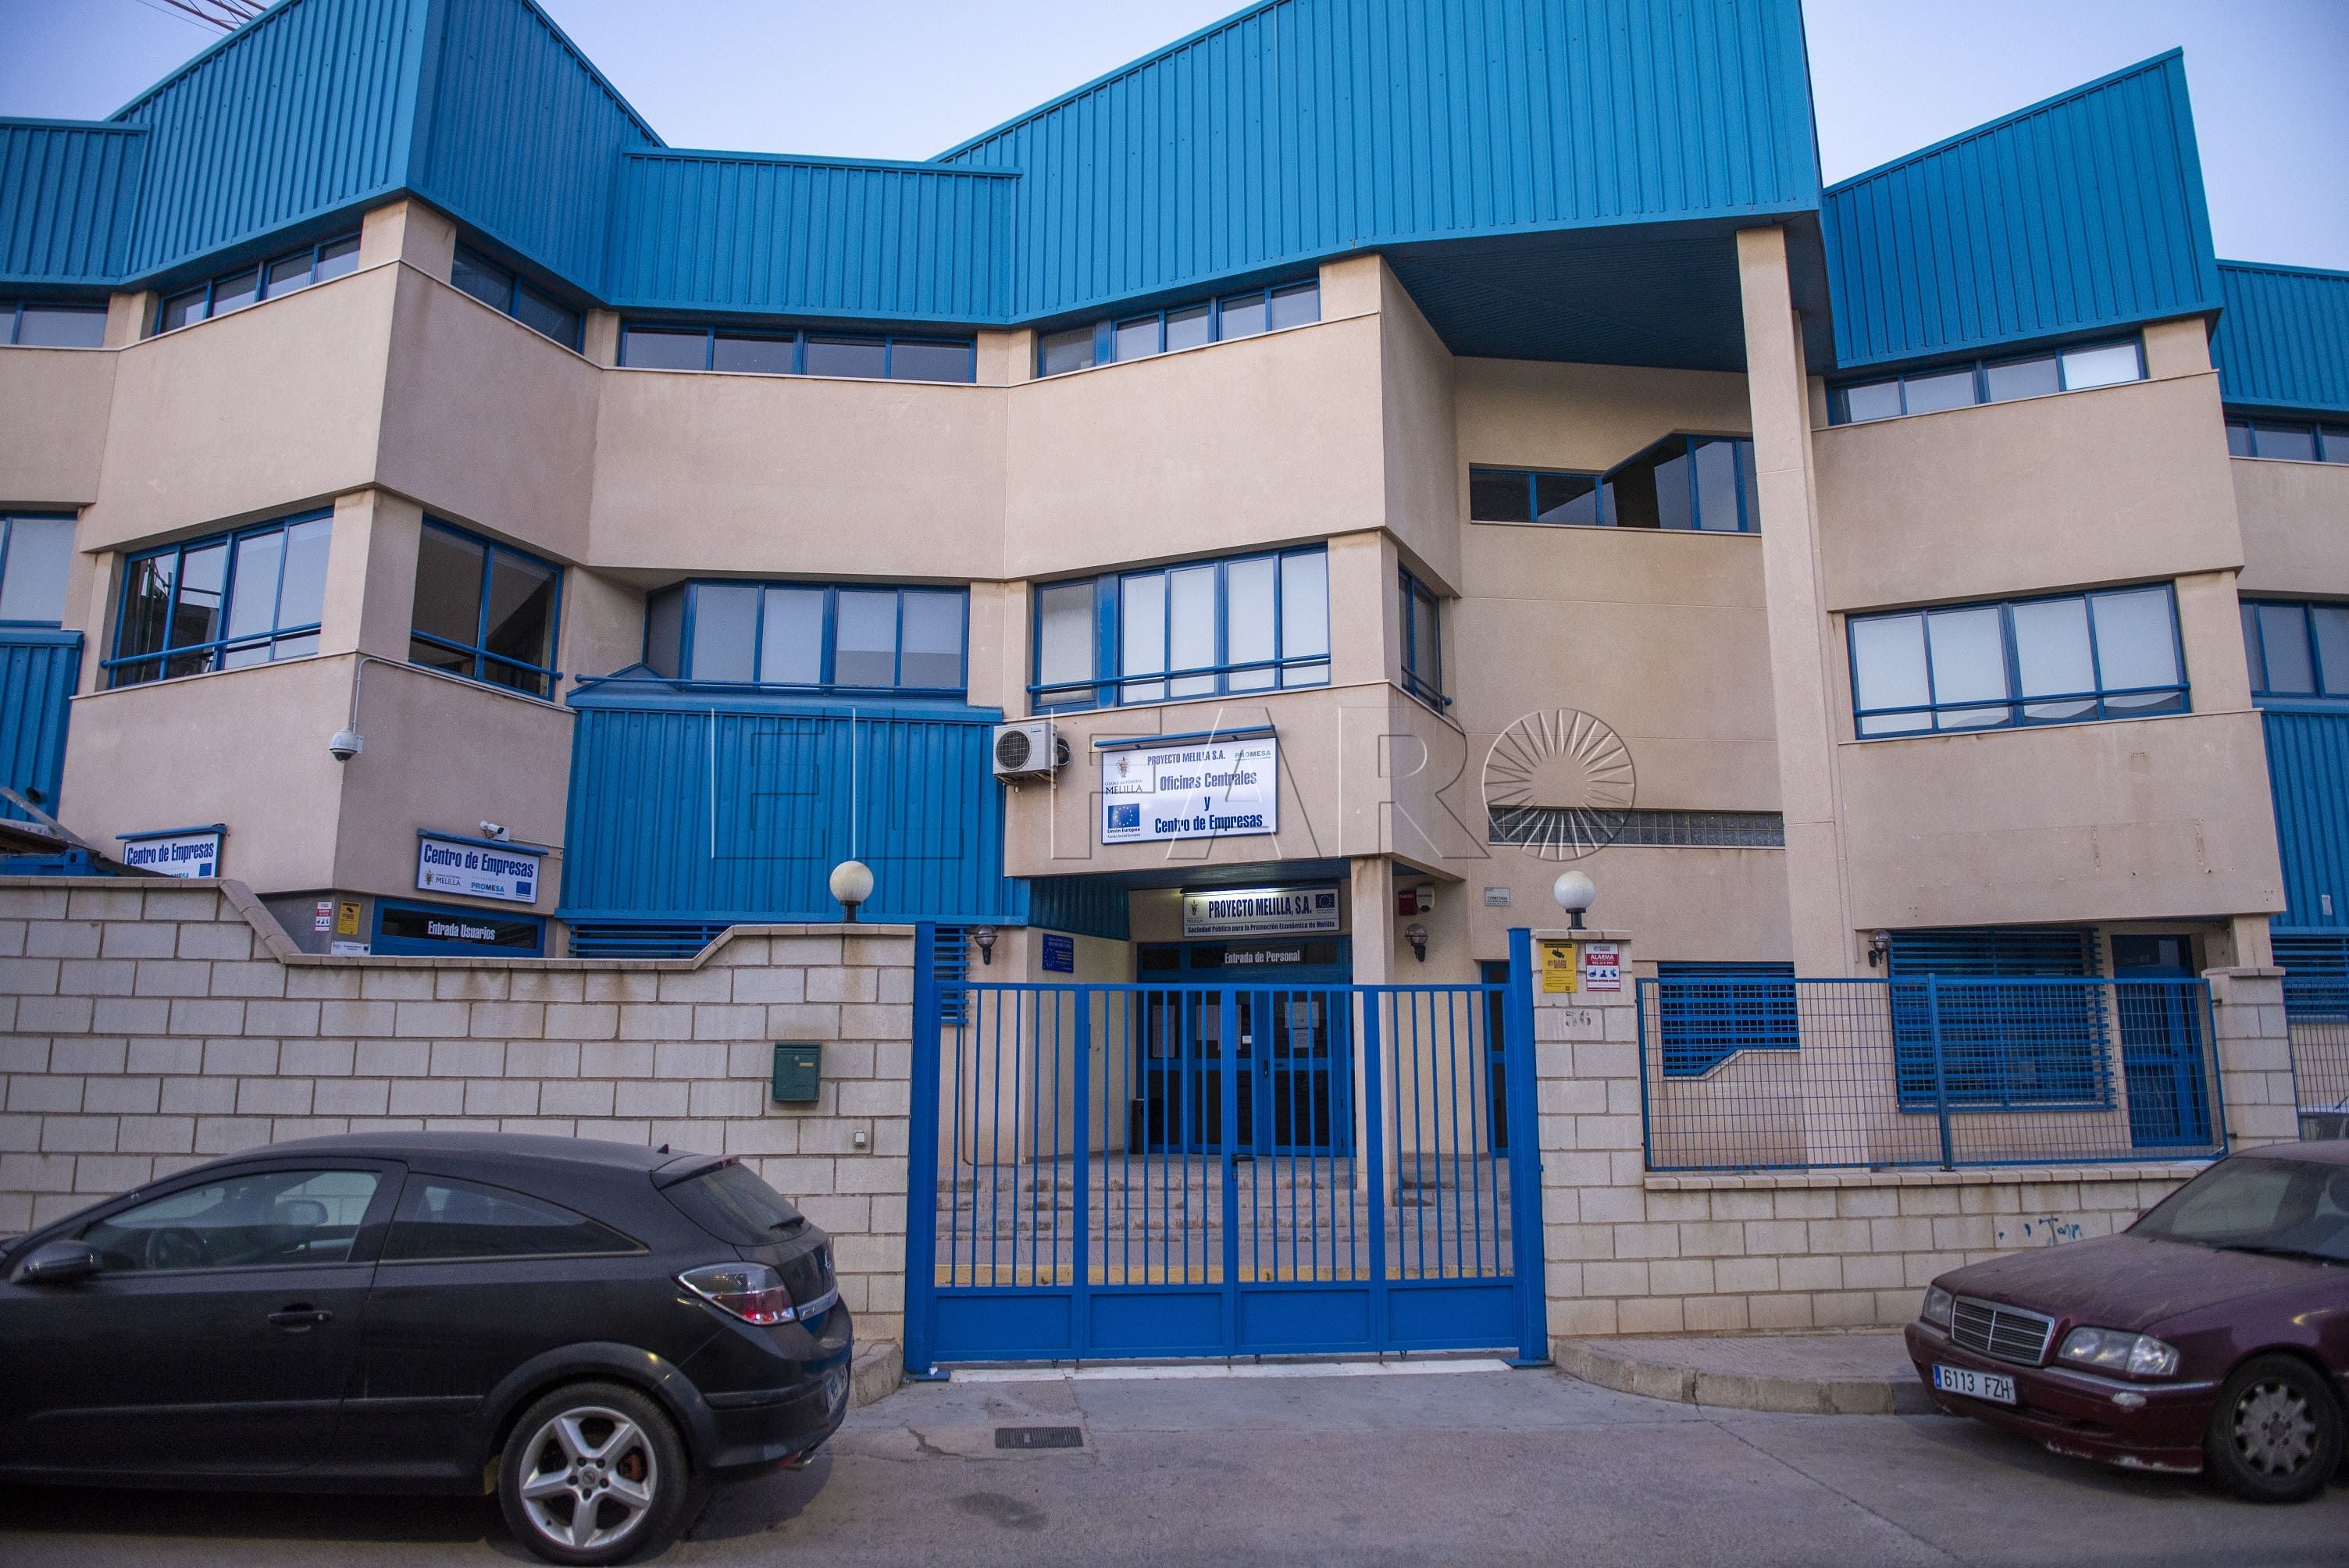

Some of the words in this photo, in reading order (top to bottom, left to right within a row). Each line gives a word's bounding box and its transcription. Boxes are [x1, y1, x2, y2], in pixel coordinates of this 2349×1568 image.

[1147, 754, 1181, 766] PROYECTO
[1182, 750, 1210, 763] MELILLA
[1212, 750, 1225, 761] S.A.
[1235, 750, 1271, 758] PROMESA
[1160, 775, 1201, 791] Oficinas
[1204, 770, 1257, 788] Centrales
[1106, 784, 1142, 795] MELILLA
[1204, 796, 1210, 811] y
[1155, 818, 1190, 833] Centro
[1193, 815, 1206, 832] de
[1209, 814, 1263, 832] Empresas
[127, 847, 156, 864] Centro
[159, 844, 169, 862] de
[172, 843, 214, 863] Empresas
[424, 844, 462, 868] Centro
[465, 851, 478, 870] de
[481, 853, 533, 878] Empresas
[436, 876, 461, 886] MELILLA
[471, 882, 504, 893] PROMESA
[1208, 898, 1253, 918] PROYECTO
[1256, 896, 1293, 916] MELILLA,
[1295, 896, 1312, 914] S.A.
[427, 921, 458, 936] Entrada
[461, 925, 496, 940] Usuarios
[1224, 952, 1253, 964] Entrada
[1255, 951, 1264, 963] de
[1266, 950, 1299, 962] Personal
[1944, 1369, 1975, 1392] 6113
[1984, 1377, 2010, 1399] FZH
